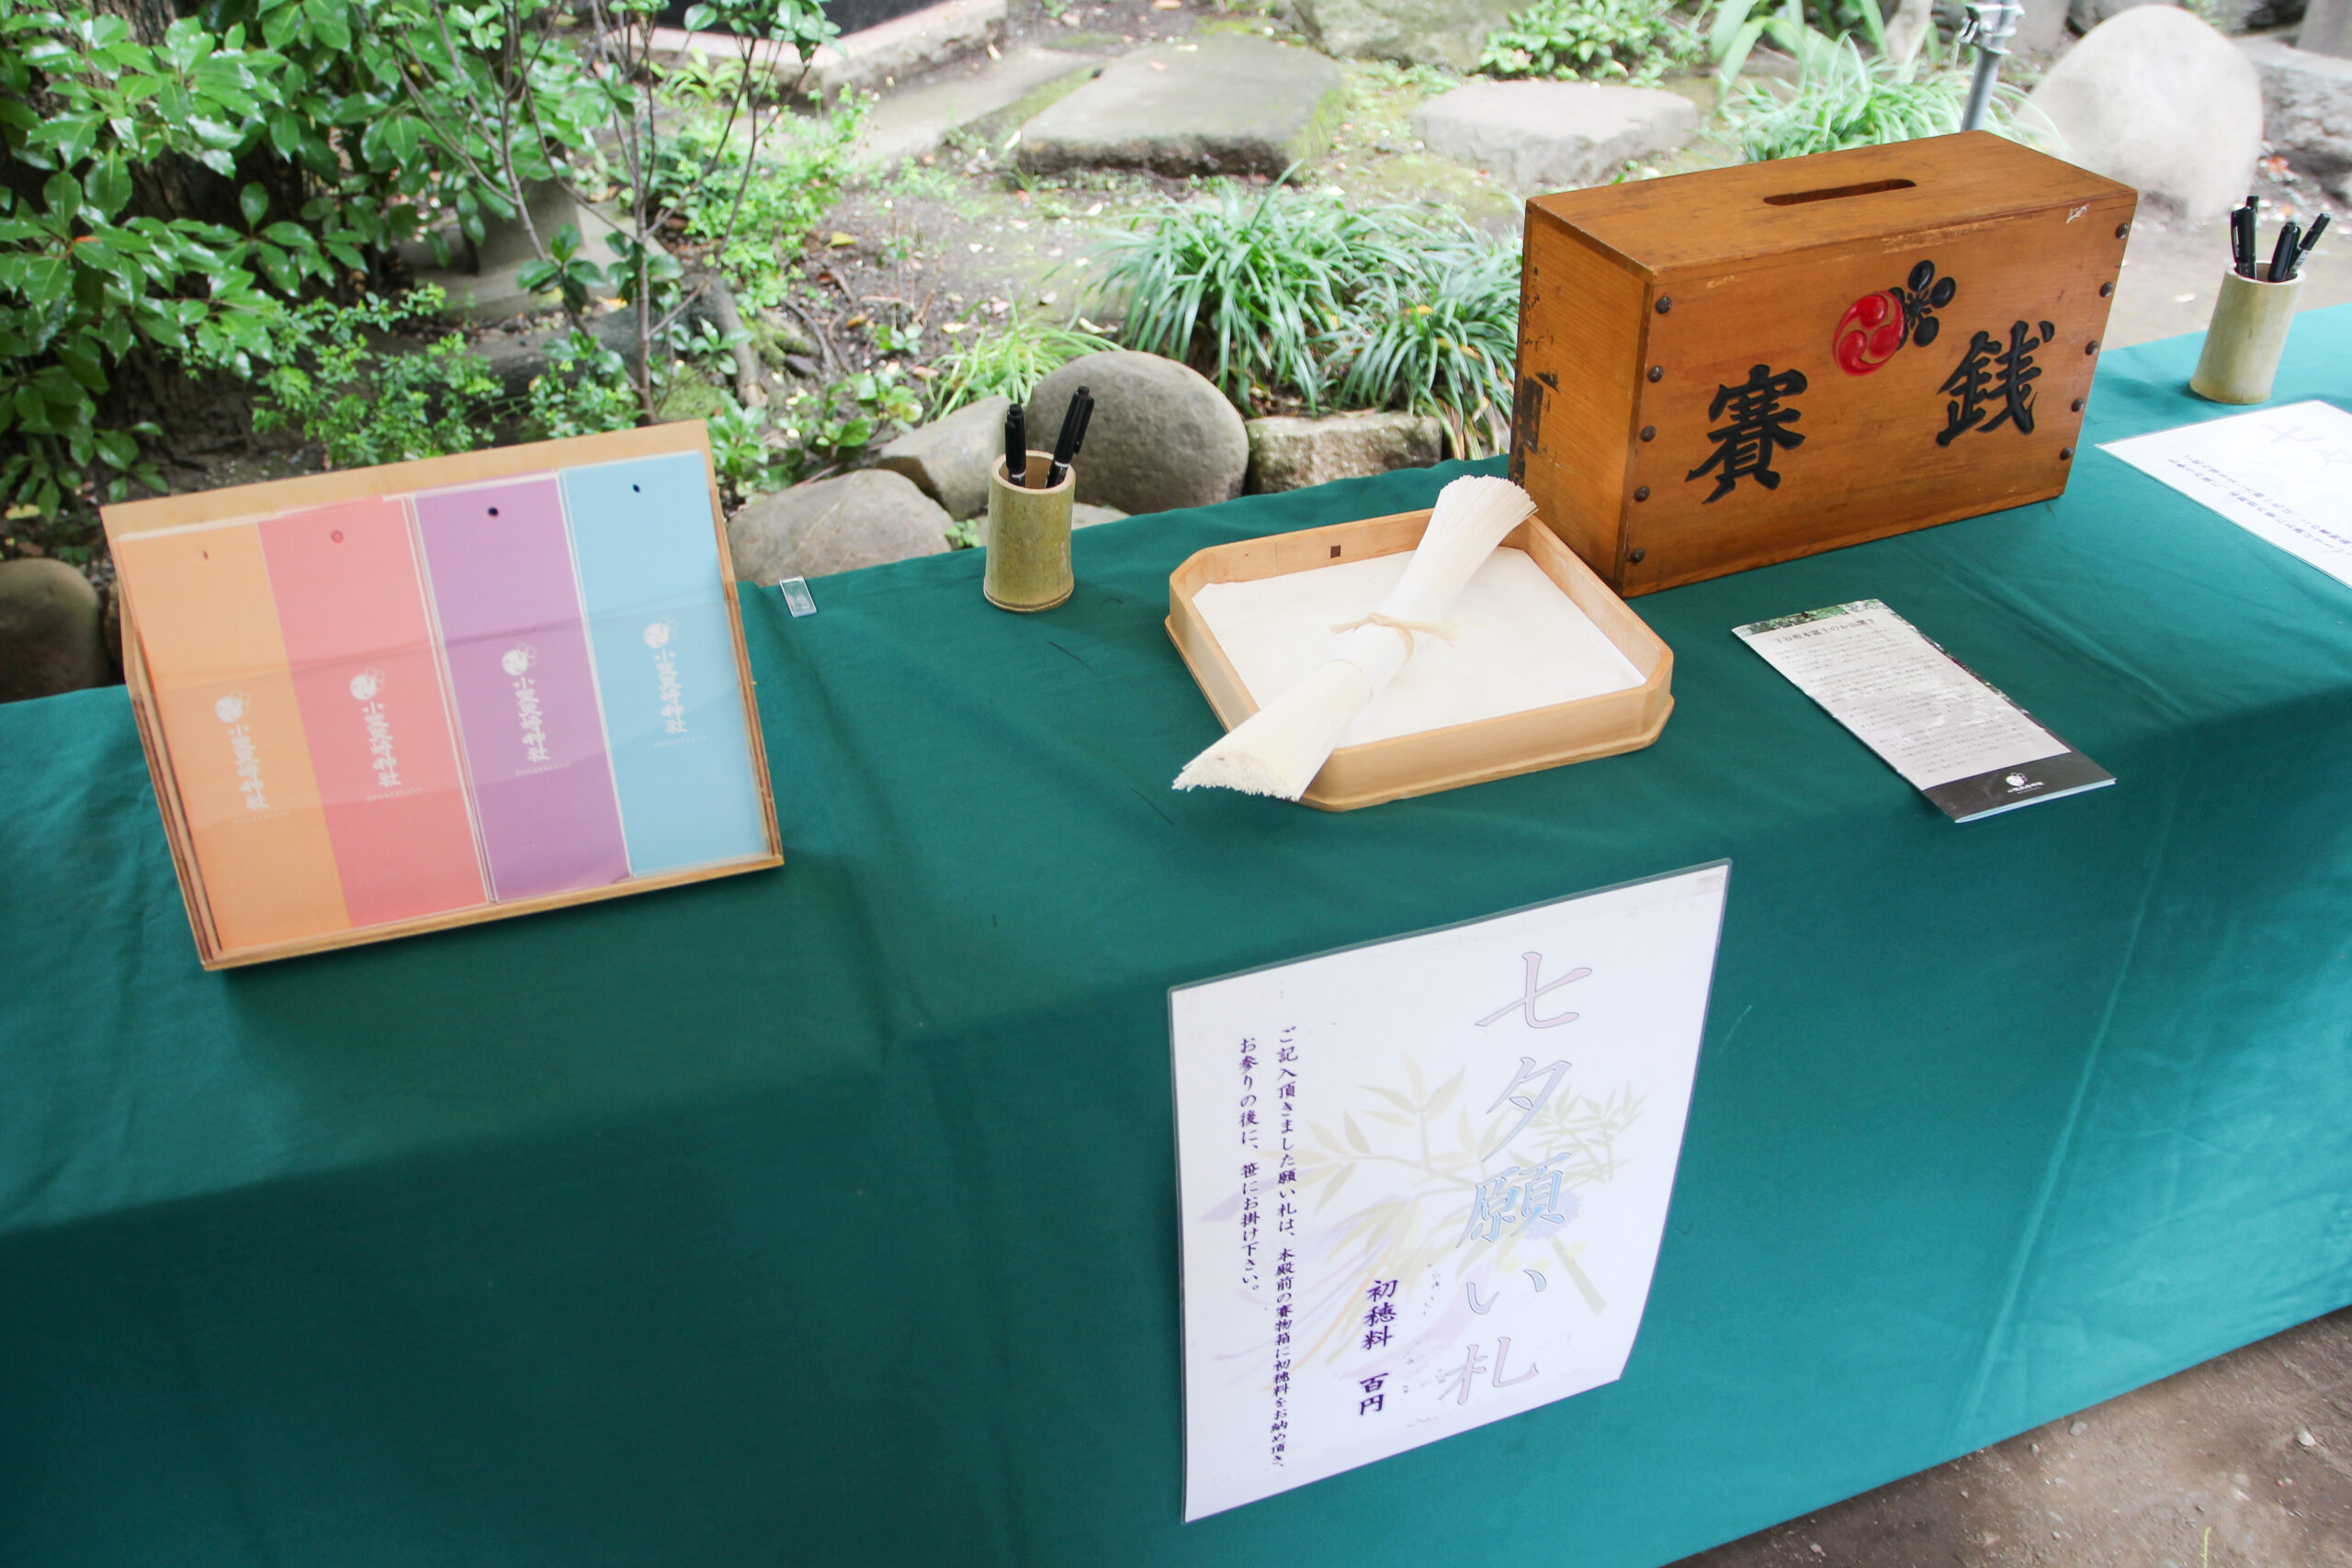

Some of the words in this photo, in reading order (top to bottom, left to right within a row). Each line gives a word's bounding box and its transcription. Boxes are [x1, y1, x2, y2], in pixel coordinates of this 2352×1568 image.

[1439, 951, 1592, 1406] 七夕願い札
[1360, 1372, 1389, 1416] 百円
